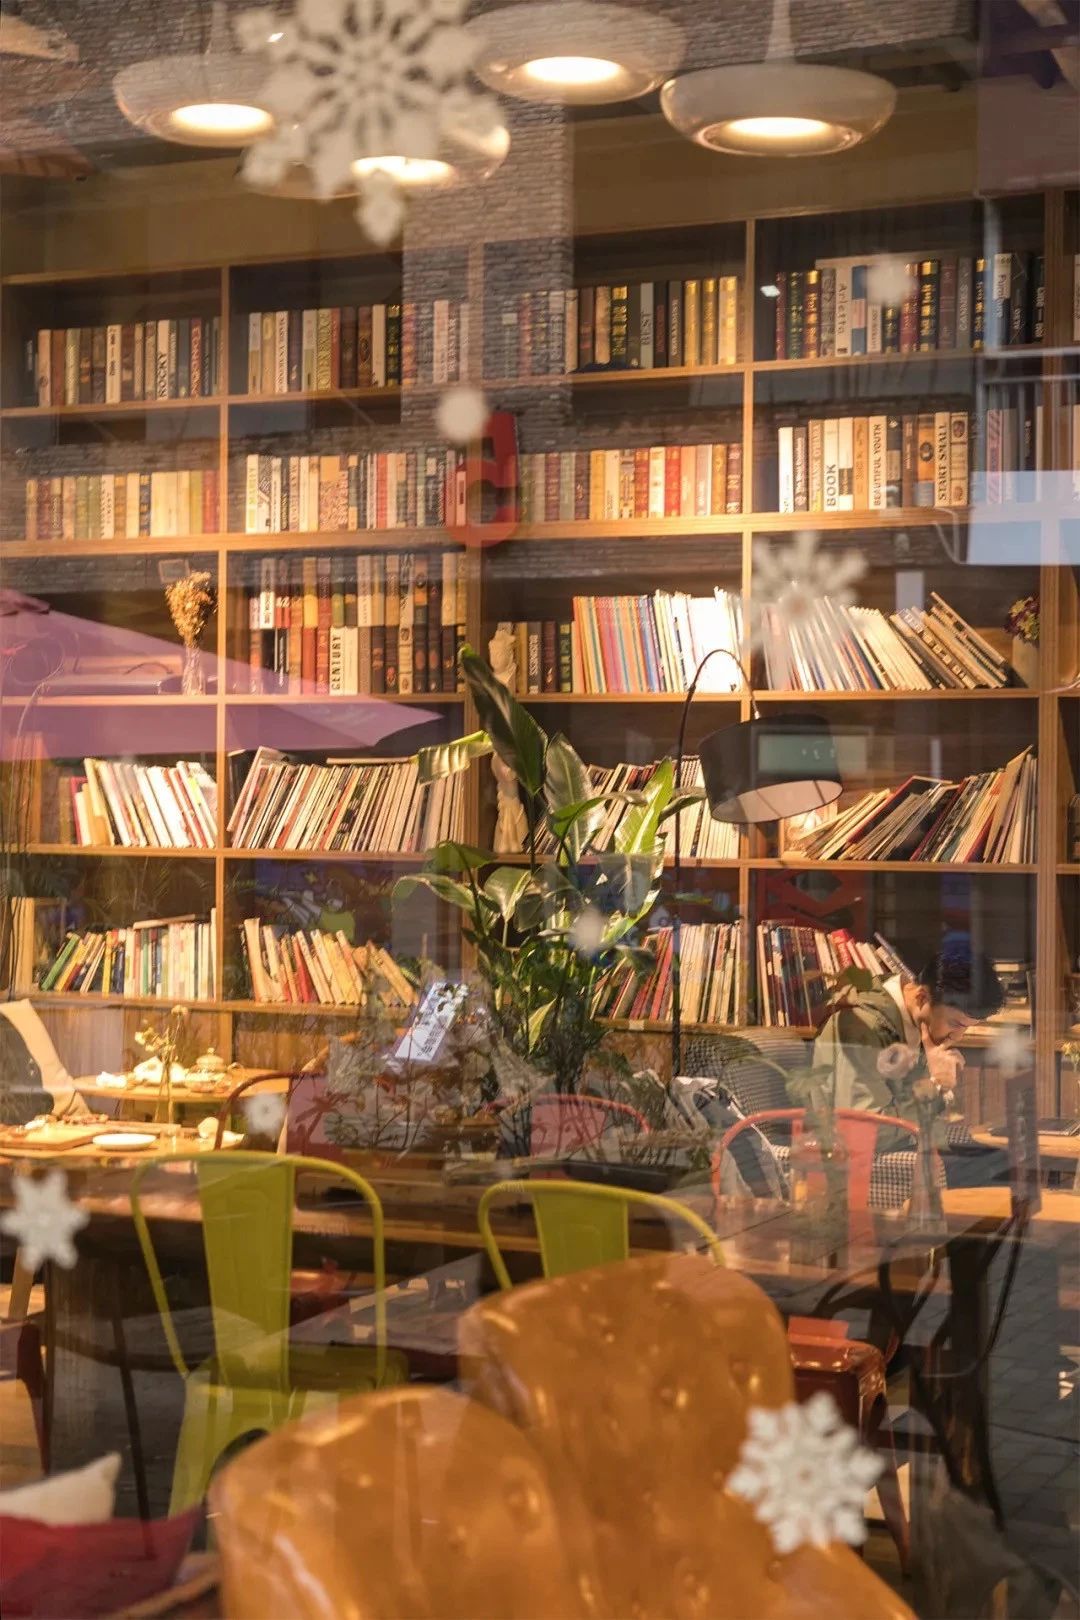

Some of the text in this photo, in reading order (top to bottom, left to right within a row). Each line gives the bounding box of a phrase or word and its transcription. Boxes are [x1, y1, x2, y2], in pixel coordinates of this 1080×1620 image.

[826, 463, 837, 507] BOOK
[873, 423, 882, 506] BEAUTIFUL YOUTH
[938, 423, 947, 501] START SMALL
[331, 634, 342, 691] CENTURY
